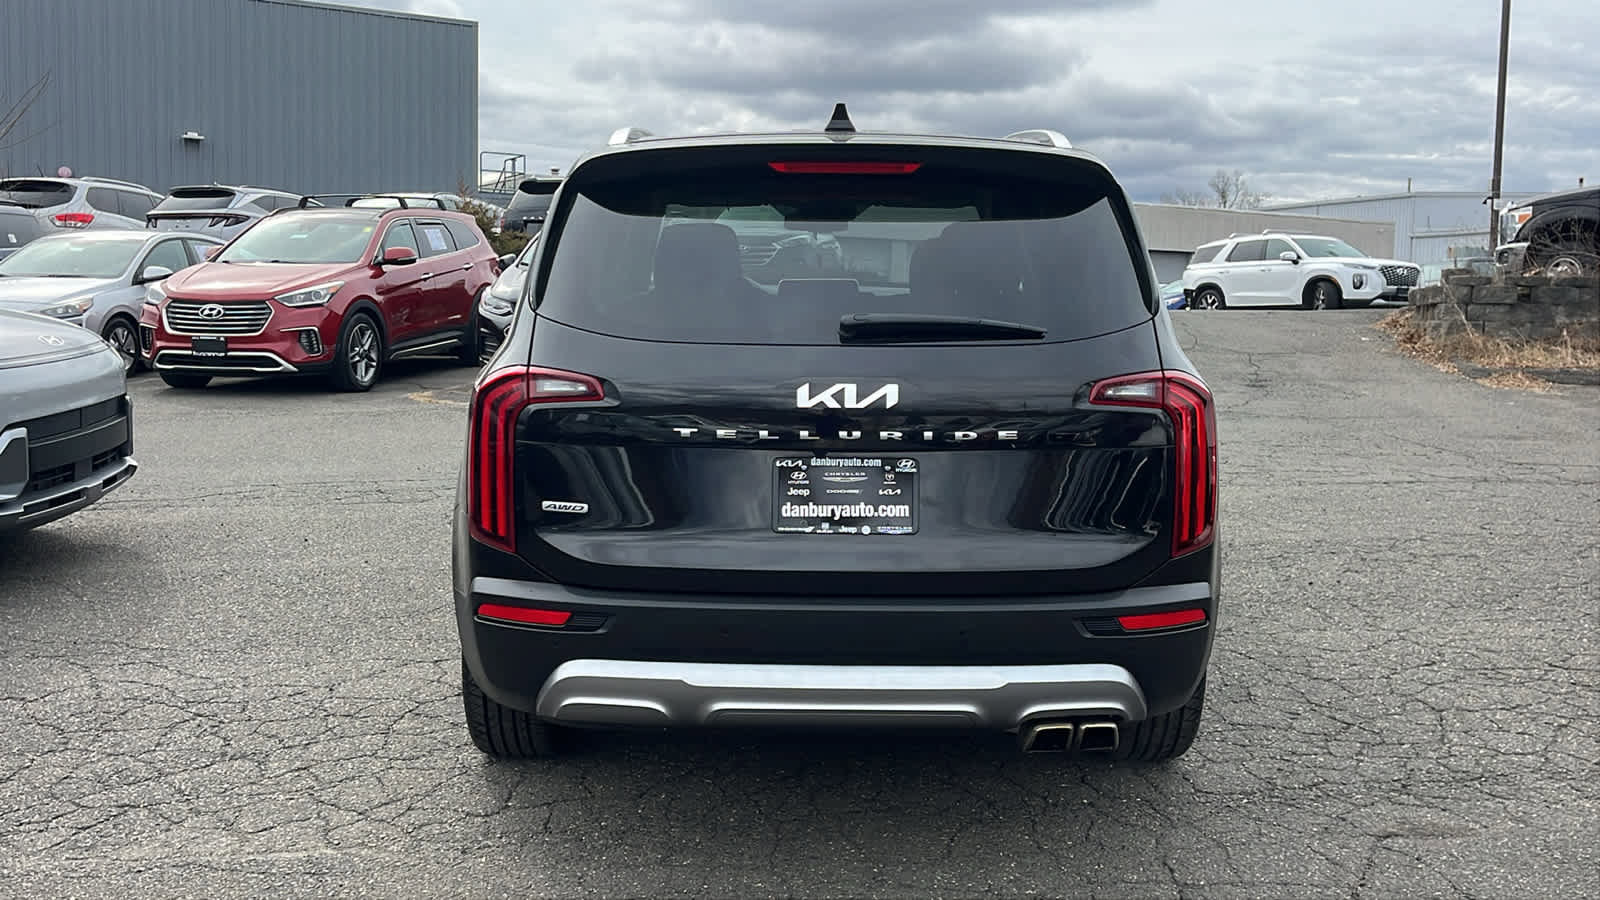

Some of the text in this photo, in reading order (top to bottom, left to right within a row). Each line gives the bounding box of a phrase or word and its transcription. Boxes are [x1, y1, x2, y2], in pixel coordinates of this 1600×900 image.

[796, 382, 899, 409] KIA
[673, 427, 1018, 440] TELLURIDE
[811, 457, 882, 468] danburyauto.com
[787, 487, 810, 496] Jeep
[543, 503, 586, 511] AWD
[781, 501, 910, 520] danburyauto.com
